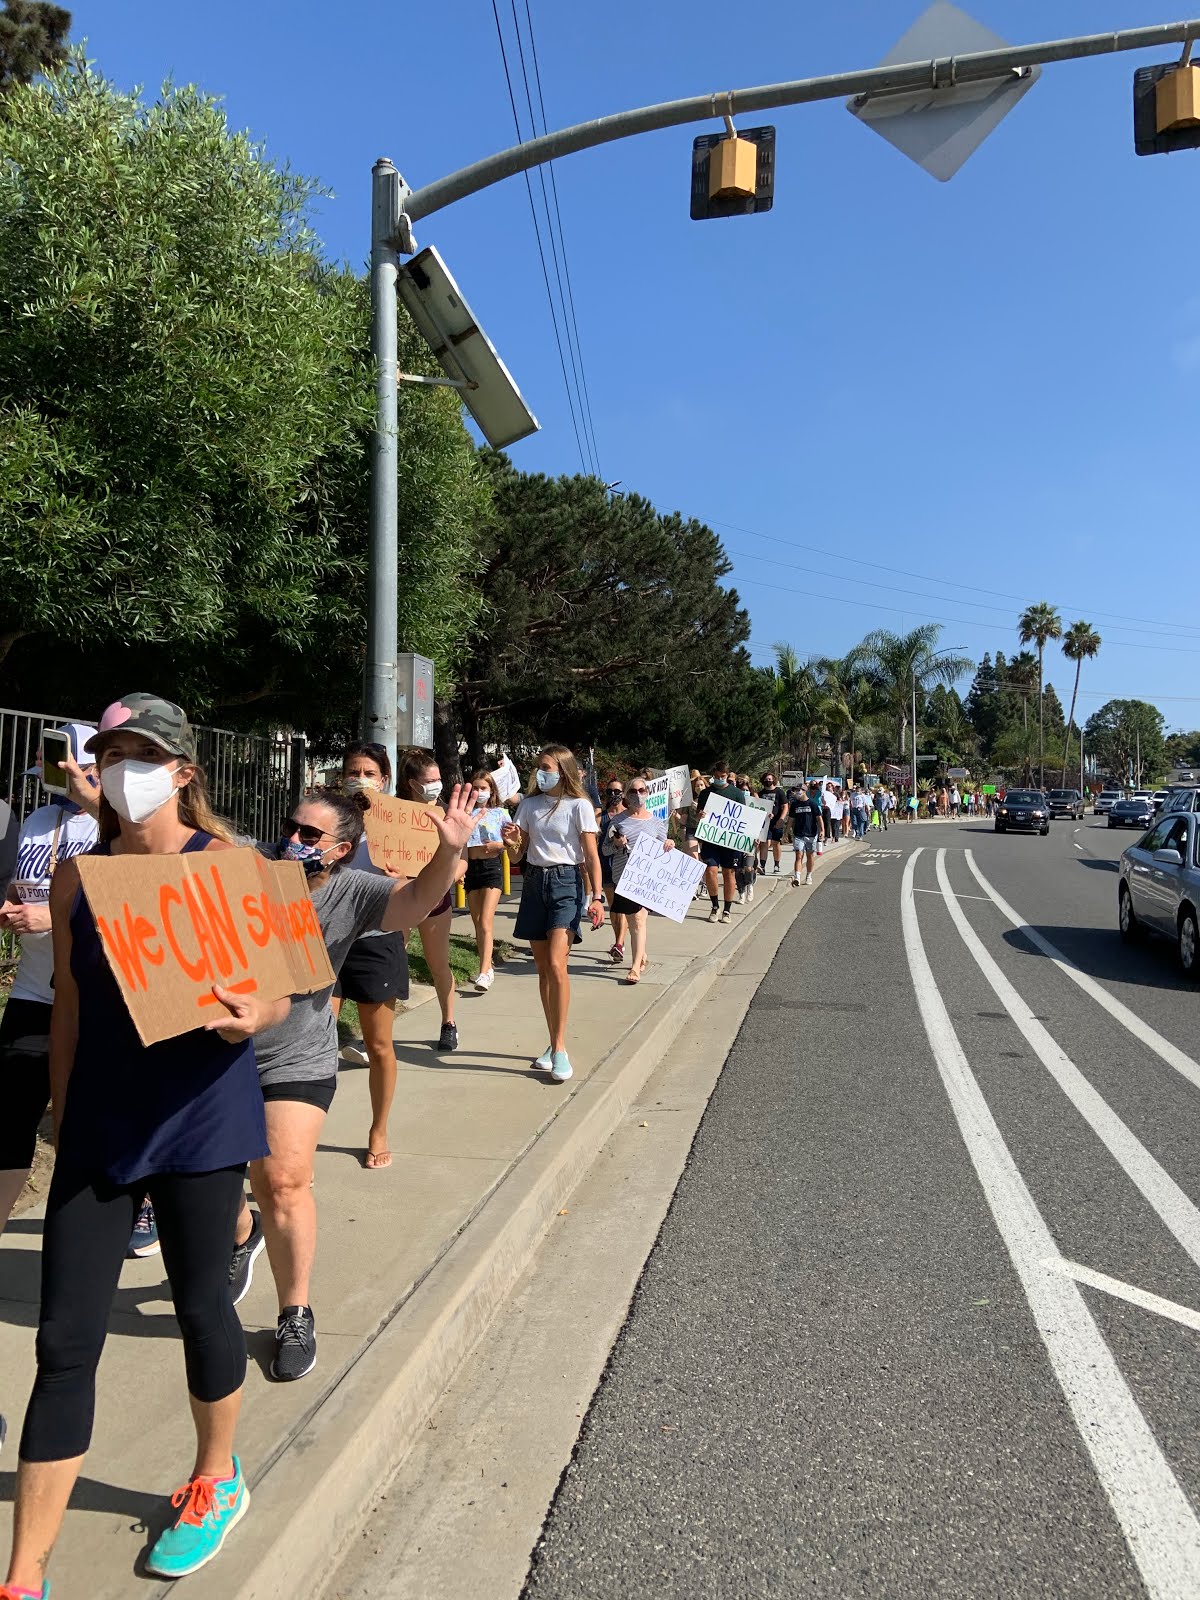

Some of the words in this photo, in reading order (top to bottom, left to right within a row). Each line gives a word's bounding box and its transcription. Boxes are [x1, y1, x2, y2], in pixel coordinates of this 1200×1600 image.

[398, 807, 407, 825] is
[722, 800, 743, 819] NO
[708, 811, 747, 835] MORE
[396, 839, 412, 861] the
[696, 822, 756, 853] ISOLATION
[627, 853, 653, 874] EACH
[673, 854, 704, 885] NEED
[622, 868, 668, 895] DISTANCE
[623, 882, 664, 904] LEARNING
[664, 899, 677, 909] IS
[98, 902, 165, 993] We
[158, 864, 249, 983] CAN
